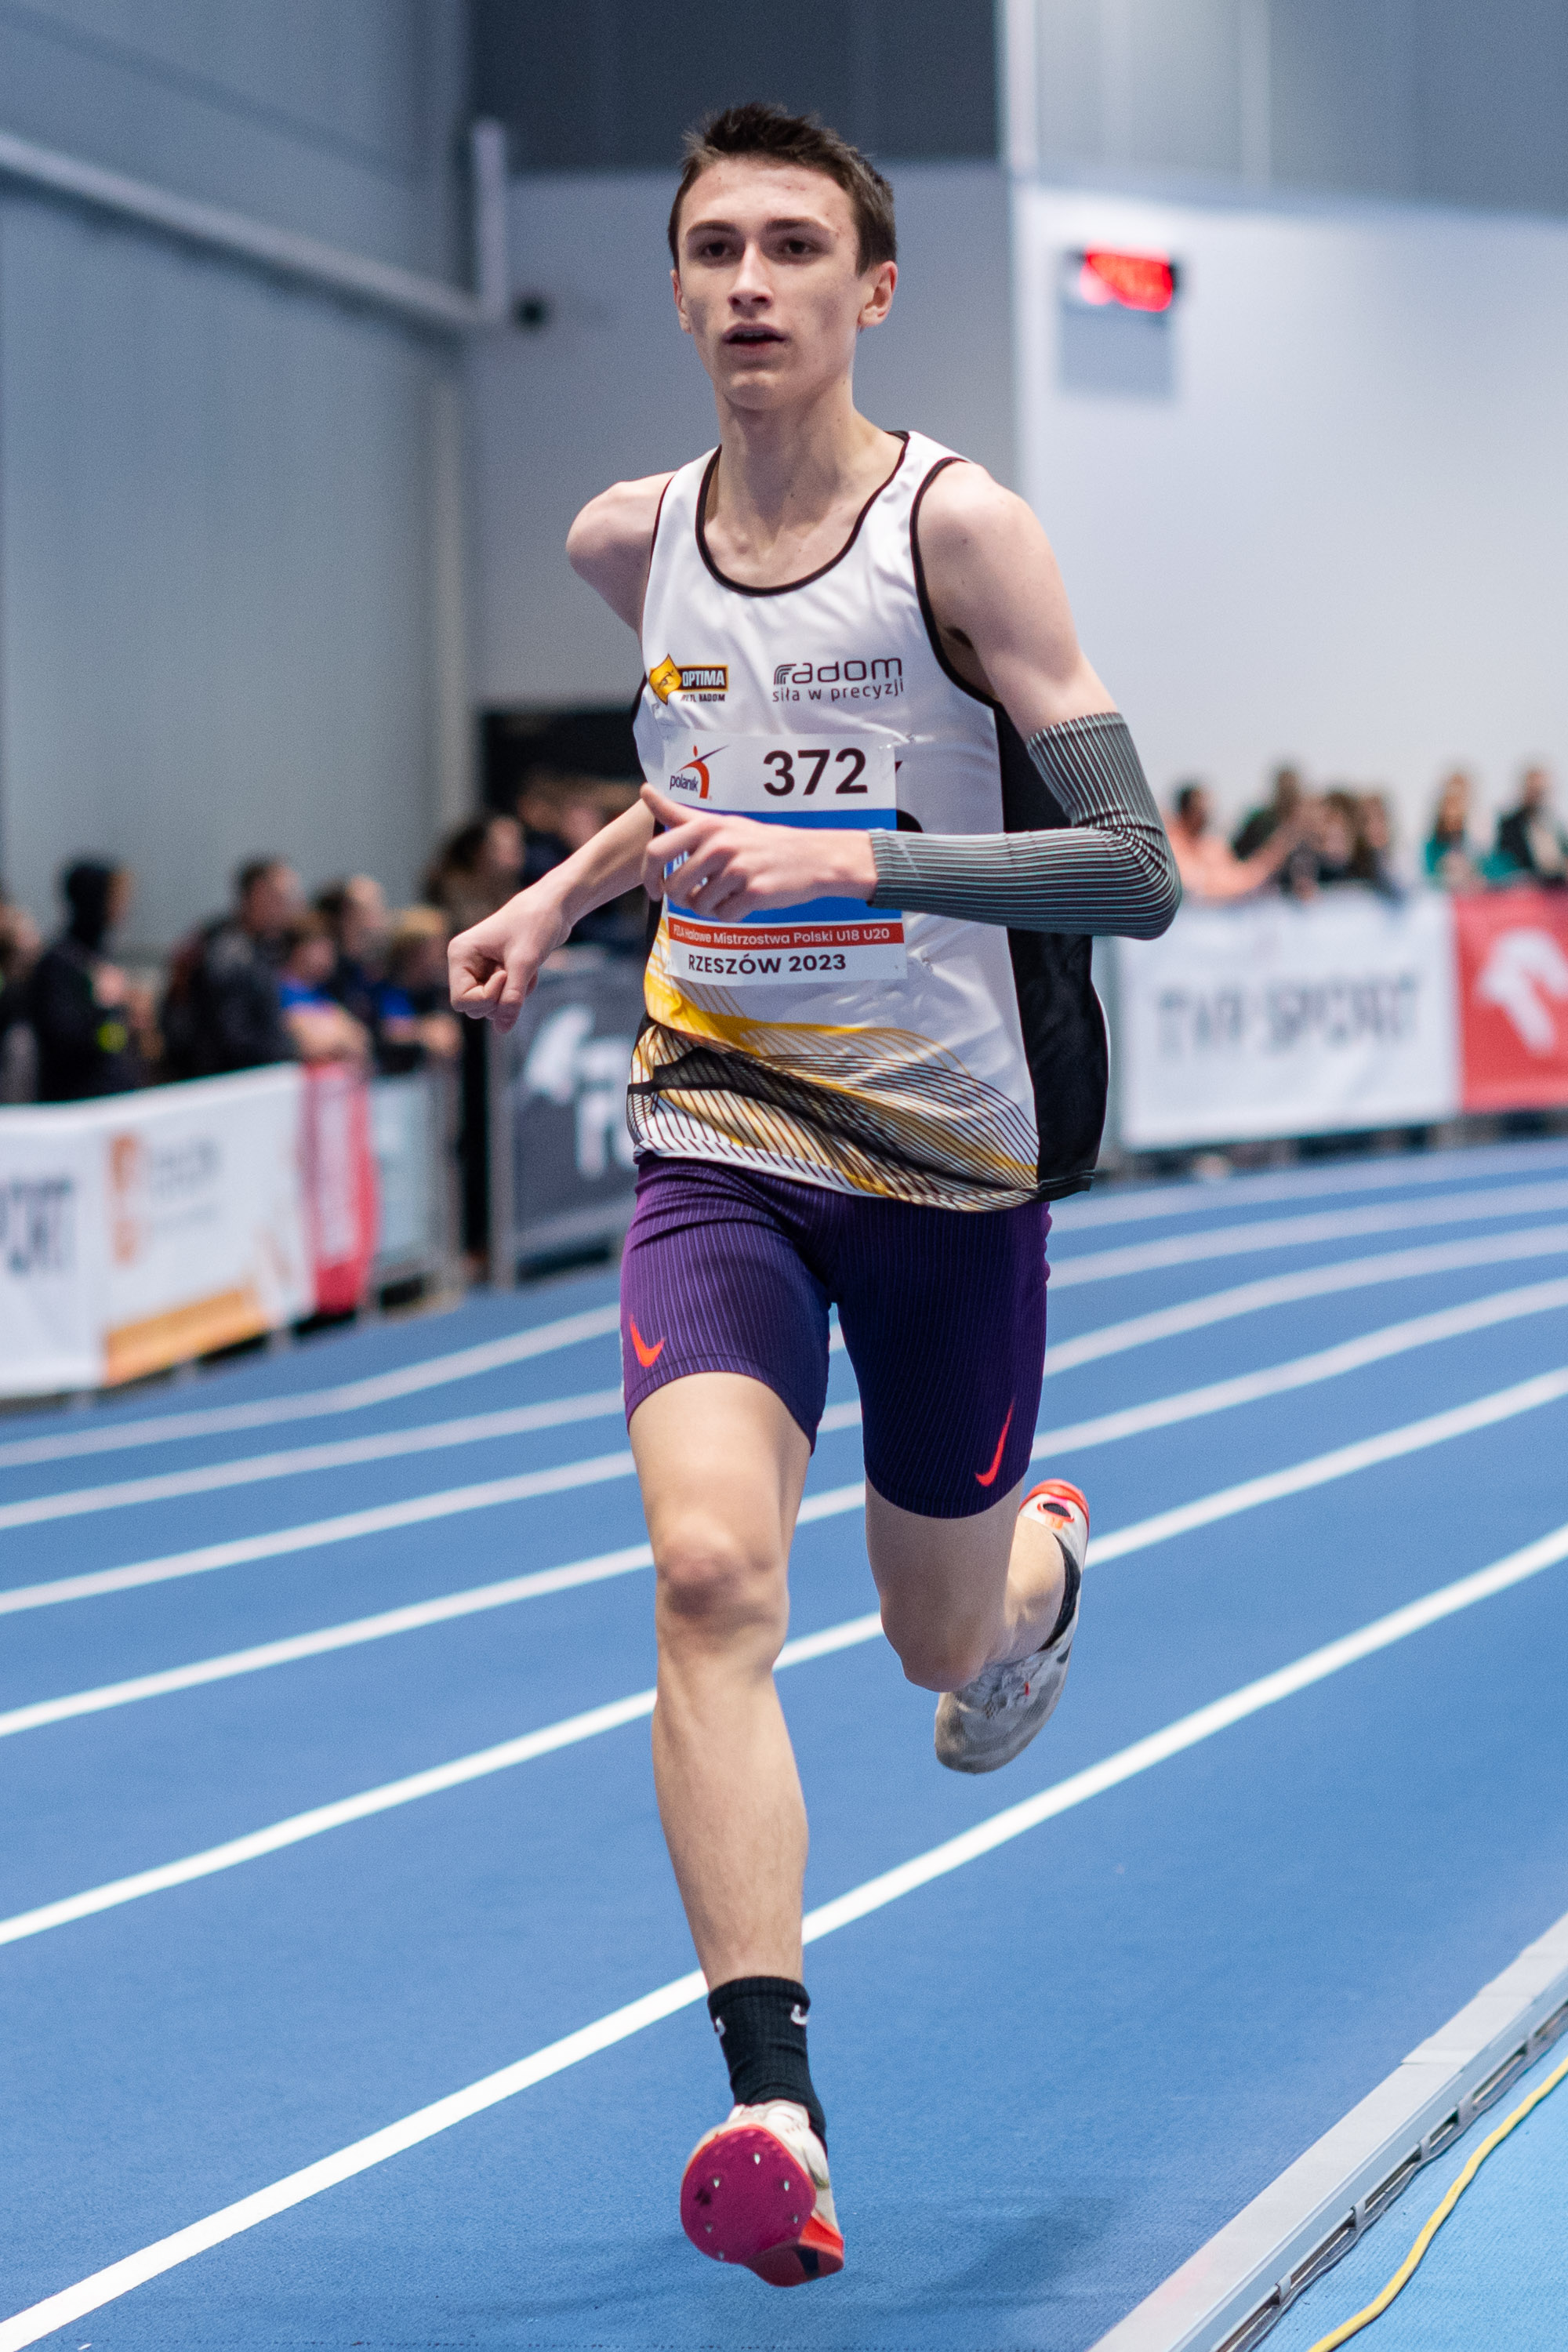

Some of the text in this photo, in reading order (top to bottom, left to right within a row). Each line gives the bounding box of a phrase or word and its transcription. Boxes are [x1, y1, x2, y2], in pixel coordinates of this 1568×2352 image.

[681, 670, 725, 687] OPTIMA
[773, 658, 902, 685] radom
[772, 677, 904, 702] siła w precyzji
[670, 773, 699, 792] polanik
[763, 747, 868, 797] 372
[713, 931, 790, 946] Mistrzostwa
[793, 931, 833, 943] Polski
[837, 929, 860, 942] U18
[863, 927, 891, 940] U20
[688, 953, 847, 975] RZESZÓW 2023
